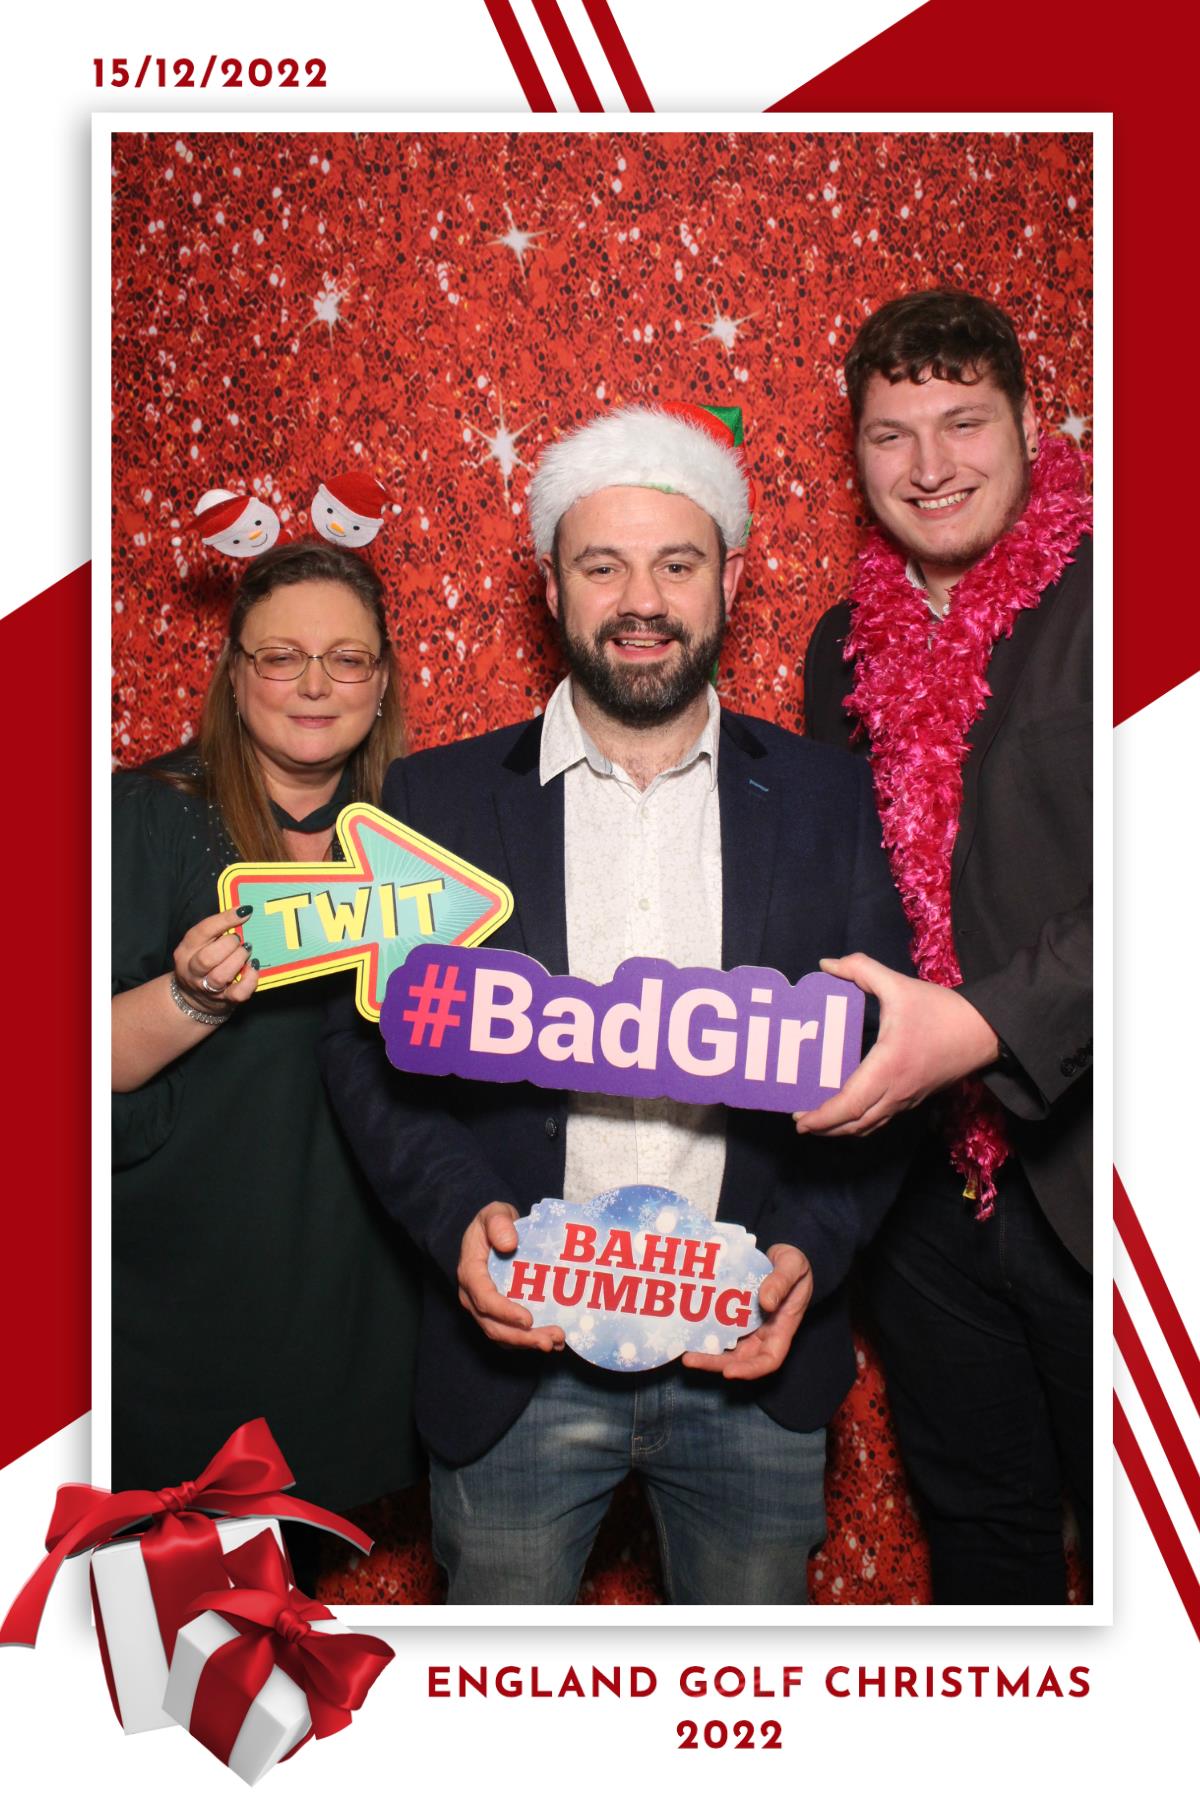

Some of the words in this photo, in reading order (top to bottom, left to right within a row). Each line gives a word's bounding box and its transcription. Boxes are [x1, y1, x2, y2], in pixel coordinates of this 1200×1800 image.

[264, 879, 445, 950] TWIT
[402, 963, 849, 1089] #BadGirl
[558, 1222, 721, 1280] BAHH
[506, 1260, 753, 1328] HUMBUG
